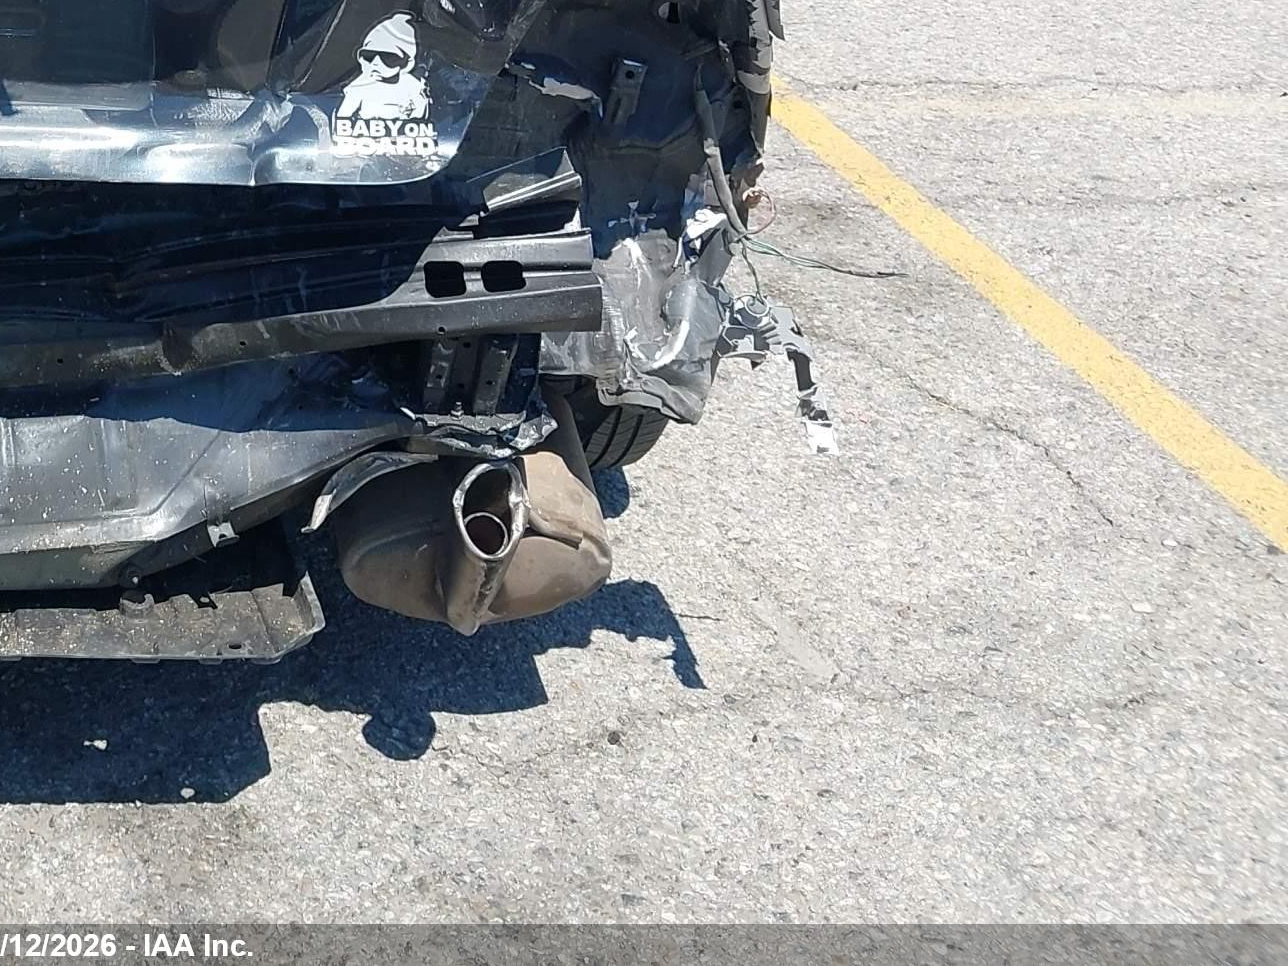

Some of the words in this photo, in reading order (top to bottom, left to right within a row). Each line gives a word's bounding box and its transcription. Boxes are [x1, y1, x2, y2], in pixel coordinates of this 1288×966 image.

[336, 119, 402, 137] BABY
[404, 123, 434, 137] ON
[335, 136, 435, 155] BOARD
